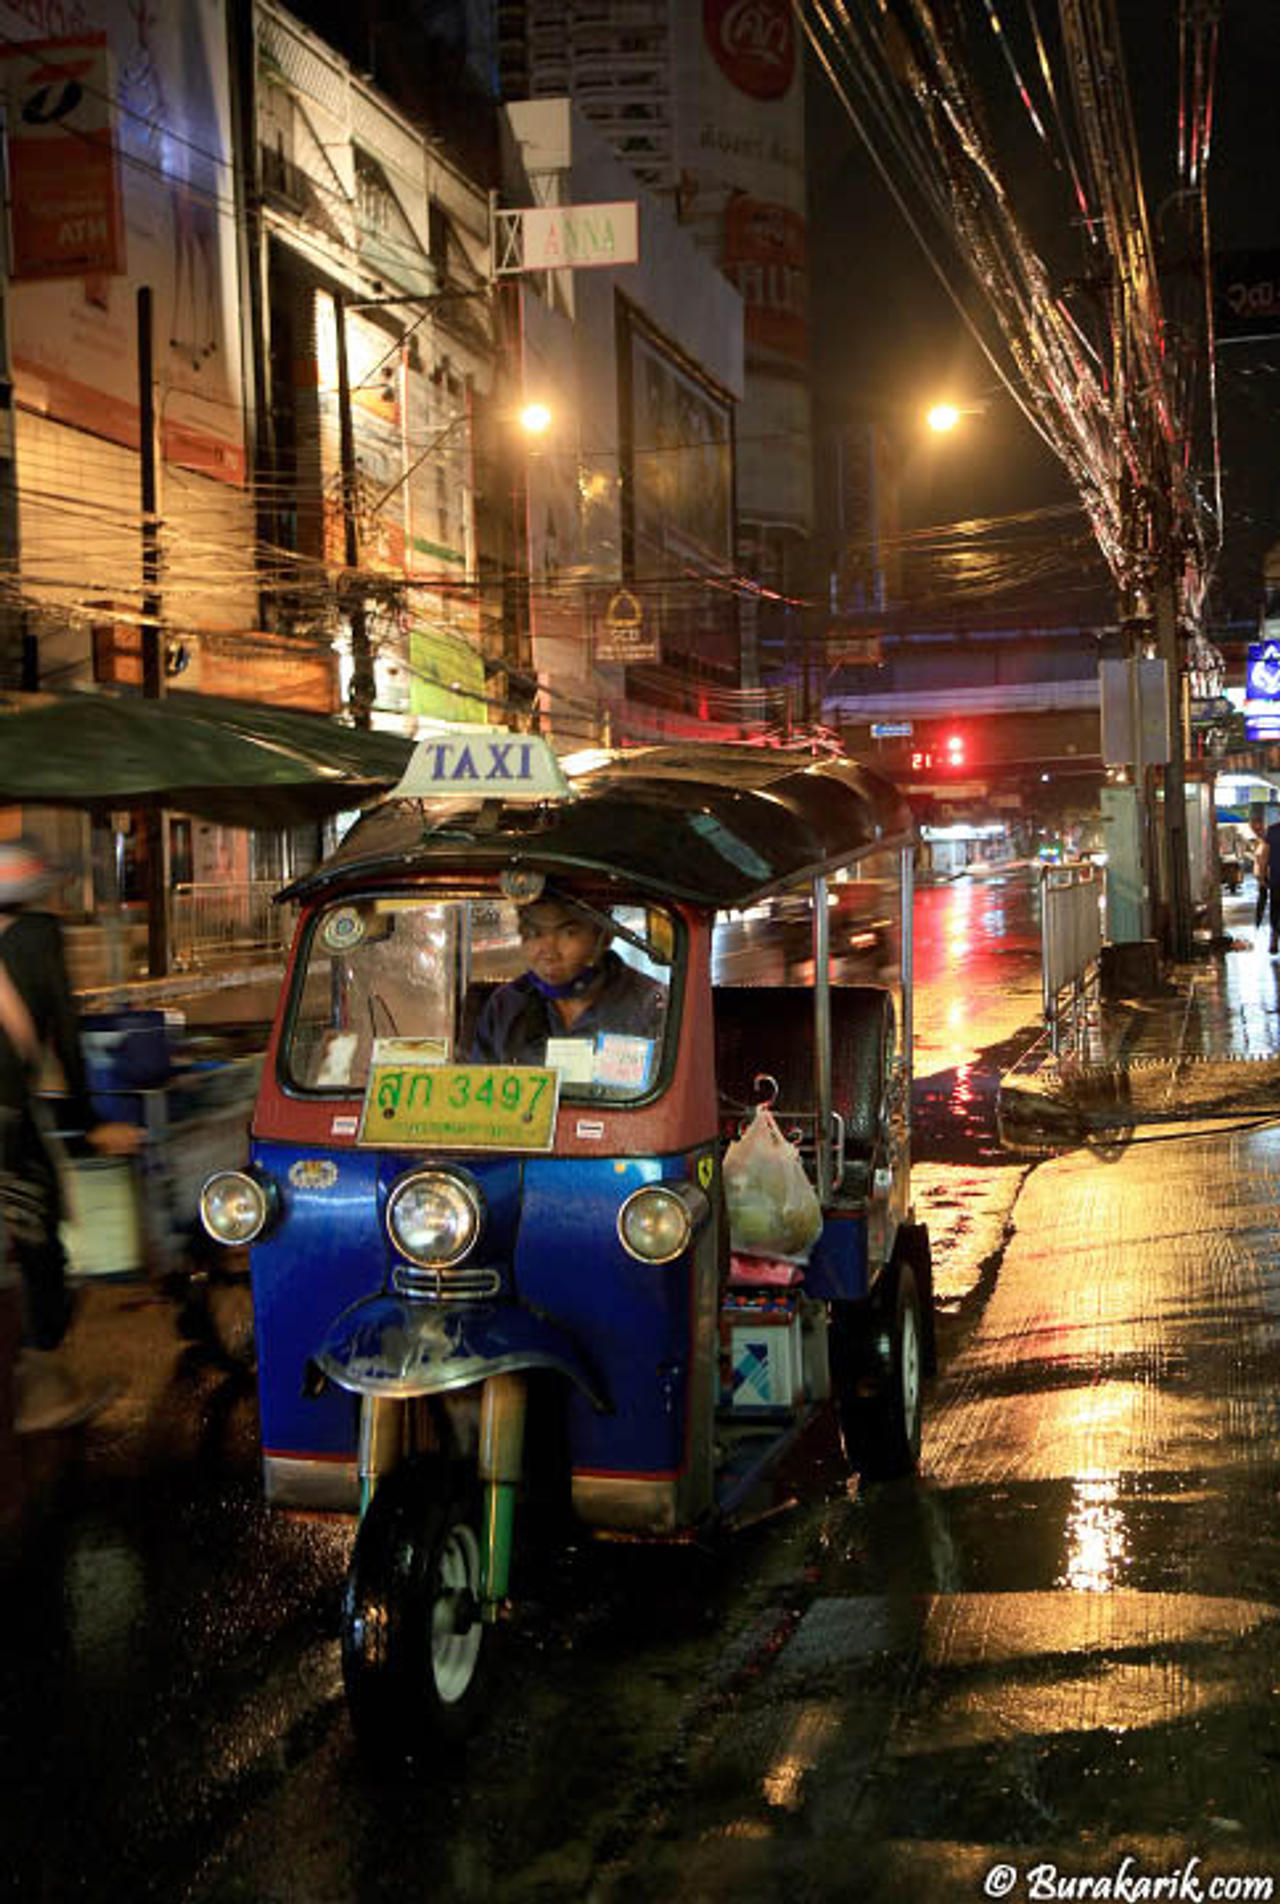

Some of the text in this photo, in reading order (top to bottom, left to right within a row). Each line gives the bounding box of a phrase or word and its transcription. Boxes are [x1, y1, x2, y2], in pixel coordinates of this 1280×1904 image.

[58, 214, 107, 246] ATM
[427, 742, 534, 781] TAXI
[911, 752, 932, 769] 21
[449, 1073, 549, 1117] 3497
